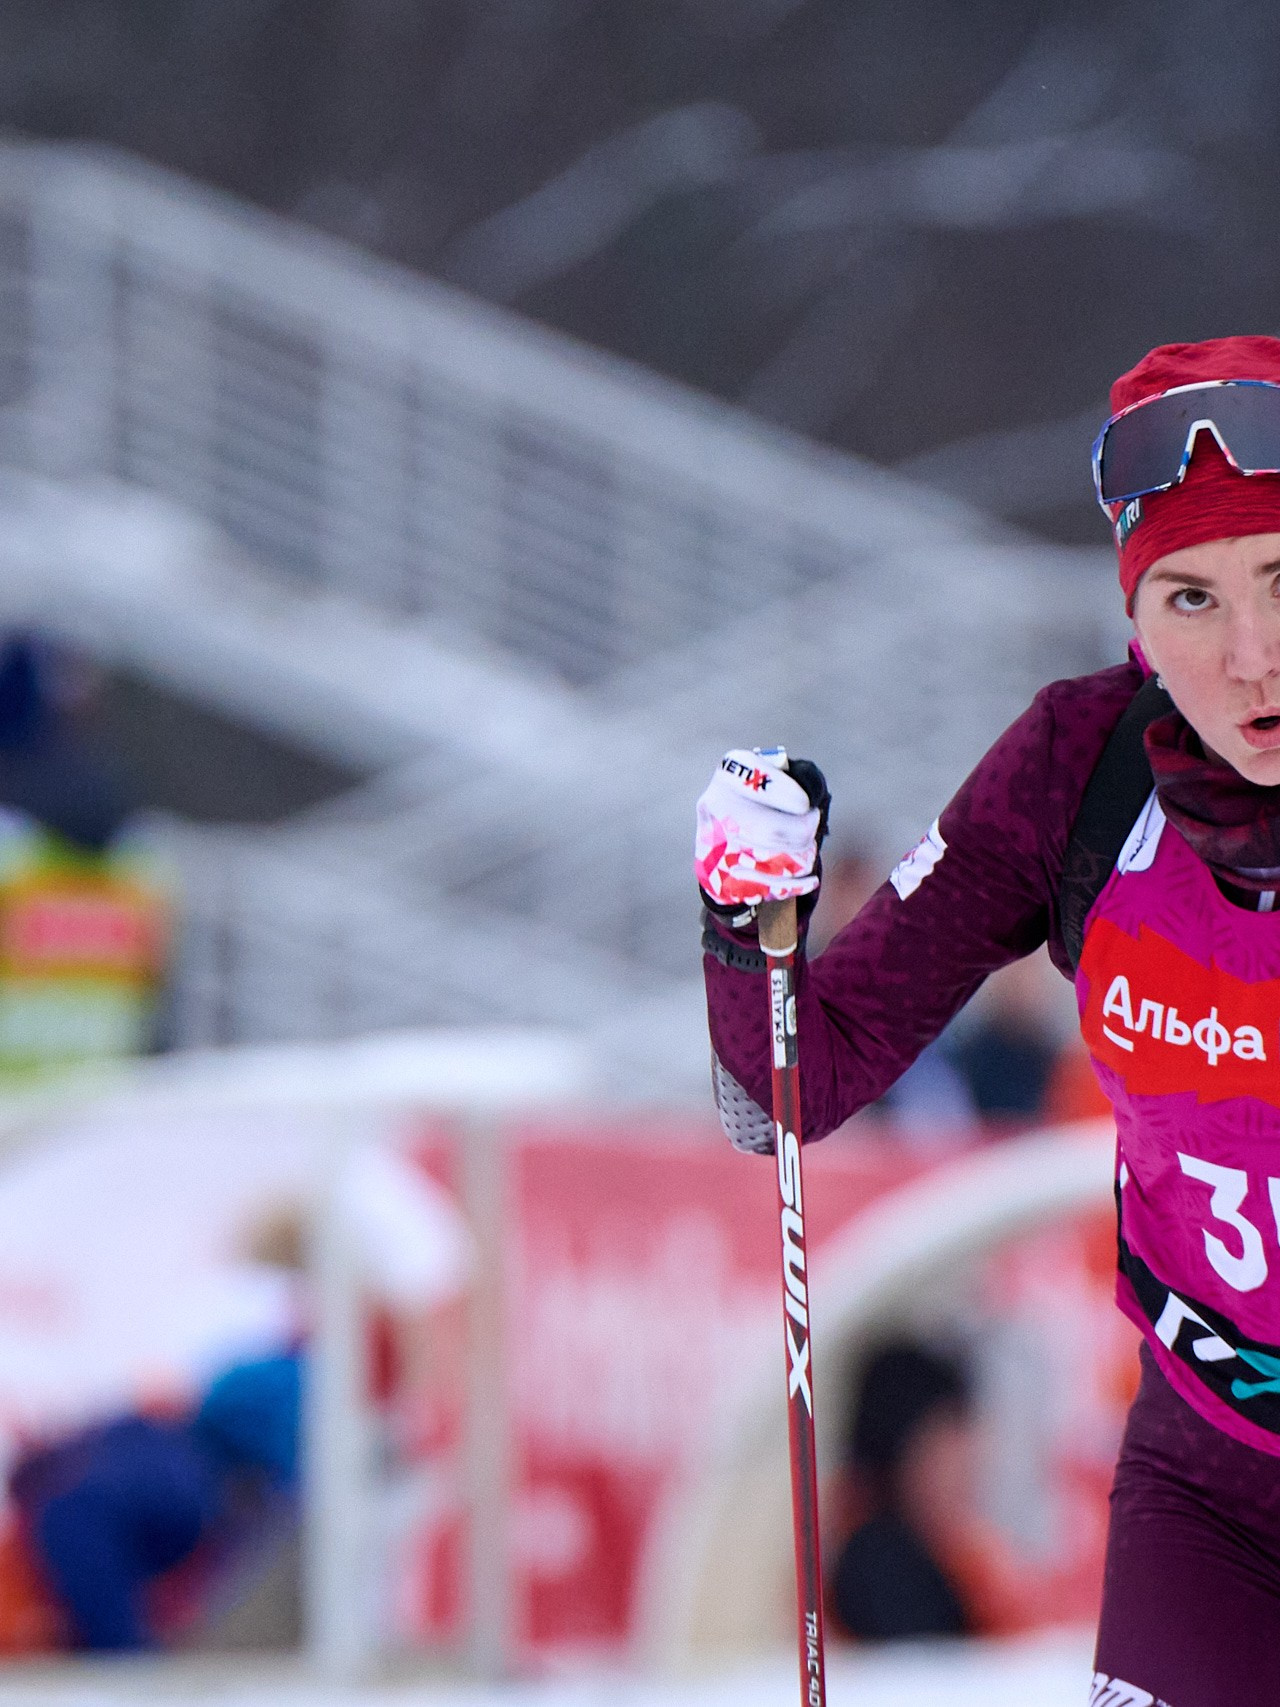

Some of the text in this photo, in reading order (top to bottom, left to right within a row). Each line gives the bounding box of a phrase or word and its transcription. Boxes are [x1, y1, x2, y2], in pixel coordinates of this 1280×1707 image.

[1102, 975, 1266, 1066] Альфа
[776, 1120, 812, 1419] SWIX
[805, 1611, 820, 1676] TRIAC
